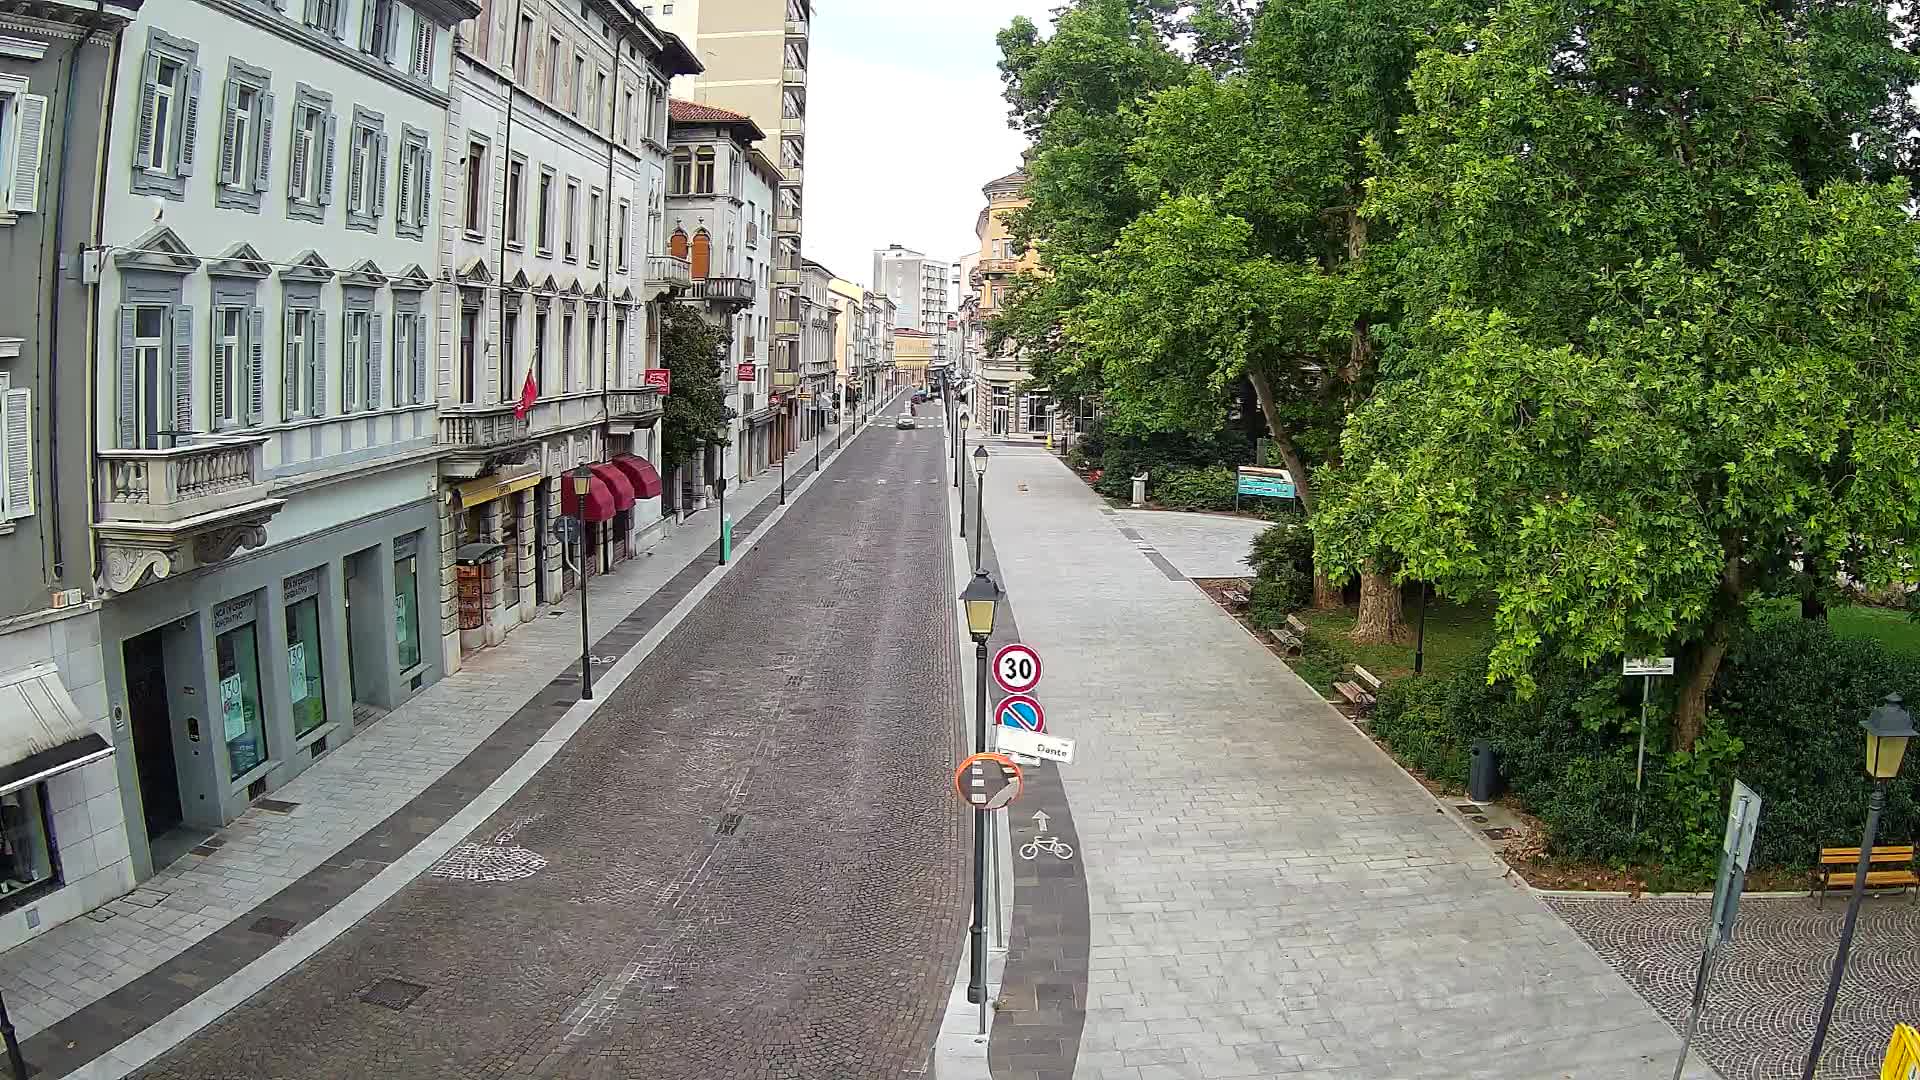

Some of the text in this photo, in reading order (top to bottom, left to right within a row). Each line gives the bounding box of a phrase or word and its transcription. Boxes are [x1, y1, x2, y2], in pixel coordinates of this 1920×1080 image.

[1005, 657, 1032, 680] 30
[222, 678, 240, 700] 130
[1037, 743, 1068, 757] Dante
